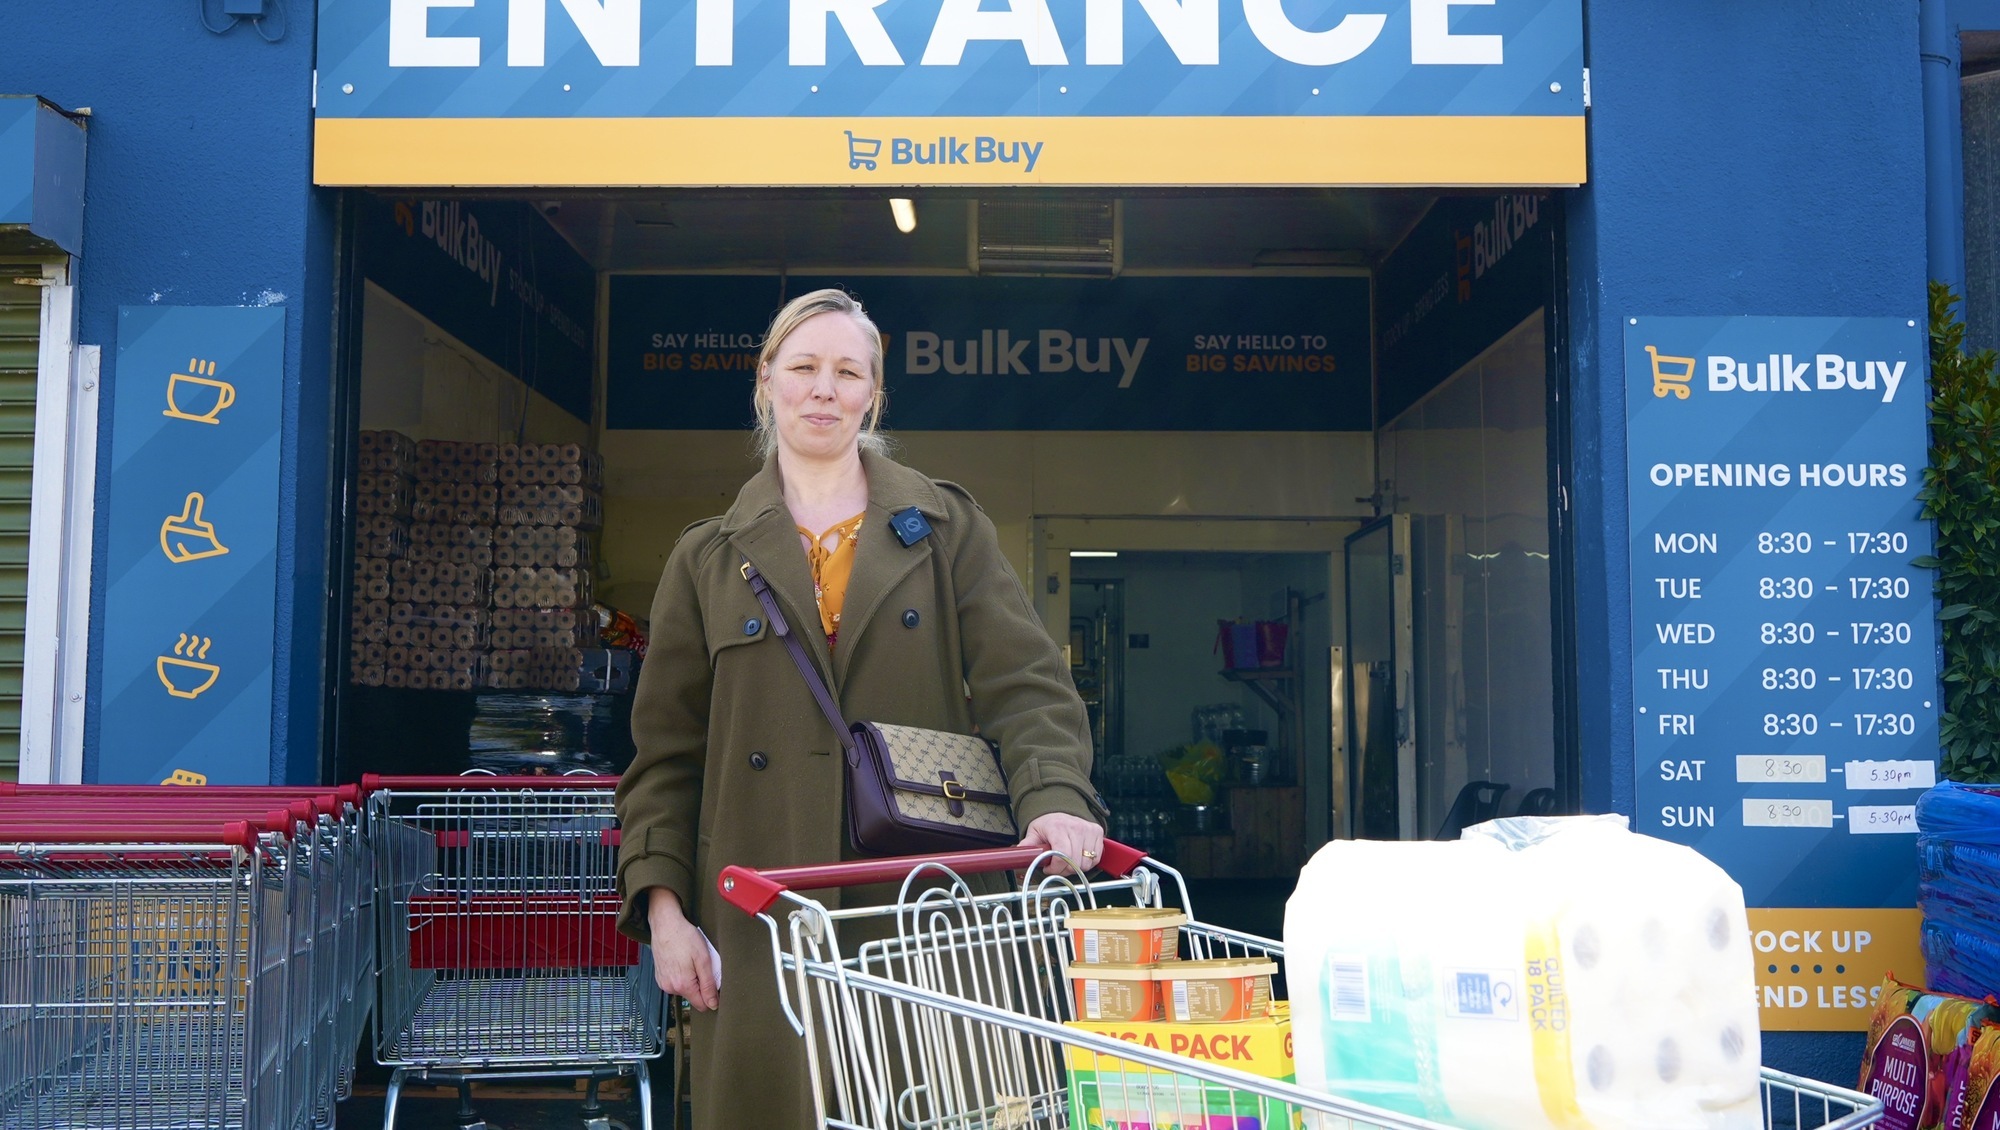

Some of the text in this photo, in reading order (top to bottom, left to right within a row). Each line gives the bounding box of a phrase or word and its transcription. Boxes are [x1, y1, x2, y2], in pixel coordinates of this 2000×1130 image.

[891, 136, 1044, 173] Bulk Buy
[652, 333, 689, 348] SAY
[694, 333, 753, 349] HELLO
[1194, 334, 1327, 350] SAY HELLO TO
[643, 353, 760, 371] BIG SAVIN
[905, 329, 1150, 388] Bulk Buy
[1186, 354, 1336, 373] BIG SAVINGS
[1707, 354, 1907, 403] Bulk Buy
[1649, 463, 1907, 487] OPENING HOURS
[1654, 532, 1717, 554] MON
[1758, 532, 1812, 554] 8:30
[1847, 532, 1908, 554] 17:30
[1655, 578, 1702, 599] TUE
[1759, 577, 1813, 599] 8:30
[1849, 577, 1910, 599] 17:30
[1655, 623, 1716, 644] WED
[1760, 622, 1815, 644] 8:30
[1850, 622, 1912, 644] 17:30
[1657, 668, 1709, 690] THU
[1762, 668, 1817, 690] 8:30
[1852, 668, 1913, 690] 17:30
[1659, 714, 1695, 735] FRI
[1763, 713, 1818, 735] 8:30
[1854, 713, 1915, 735] 17:30
[1660, 759, 1706, 781] SAT
[1661, 805, 1715, 827] SUN
[1749, 930, 1872, 953] OCK UP
[1527, 959, 1548, 1031] 18 PACK
[1545, 958, 1566, 1032] QUILTED
[1092, 1031, 1160, 1056] GGA
[1170, 1032, 1253, 1061] PACK
[1883, 1055, 1917, 1088] MULTI
[1871, 1078, 1919, 1117] PURPOSE
